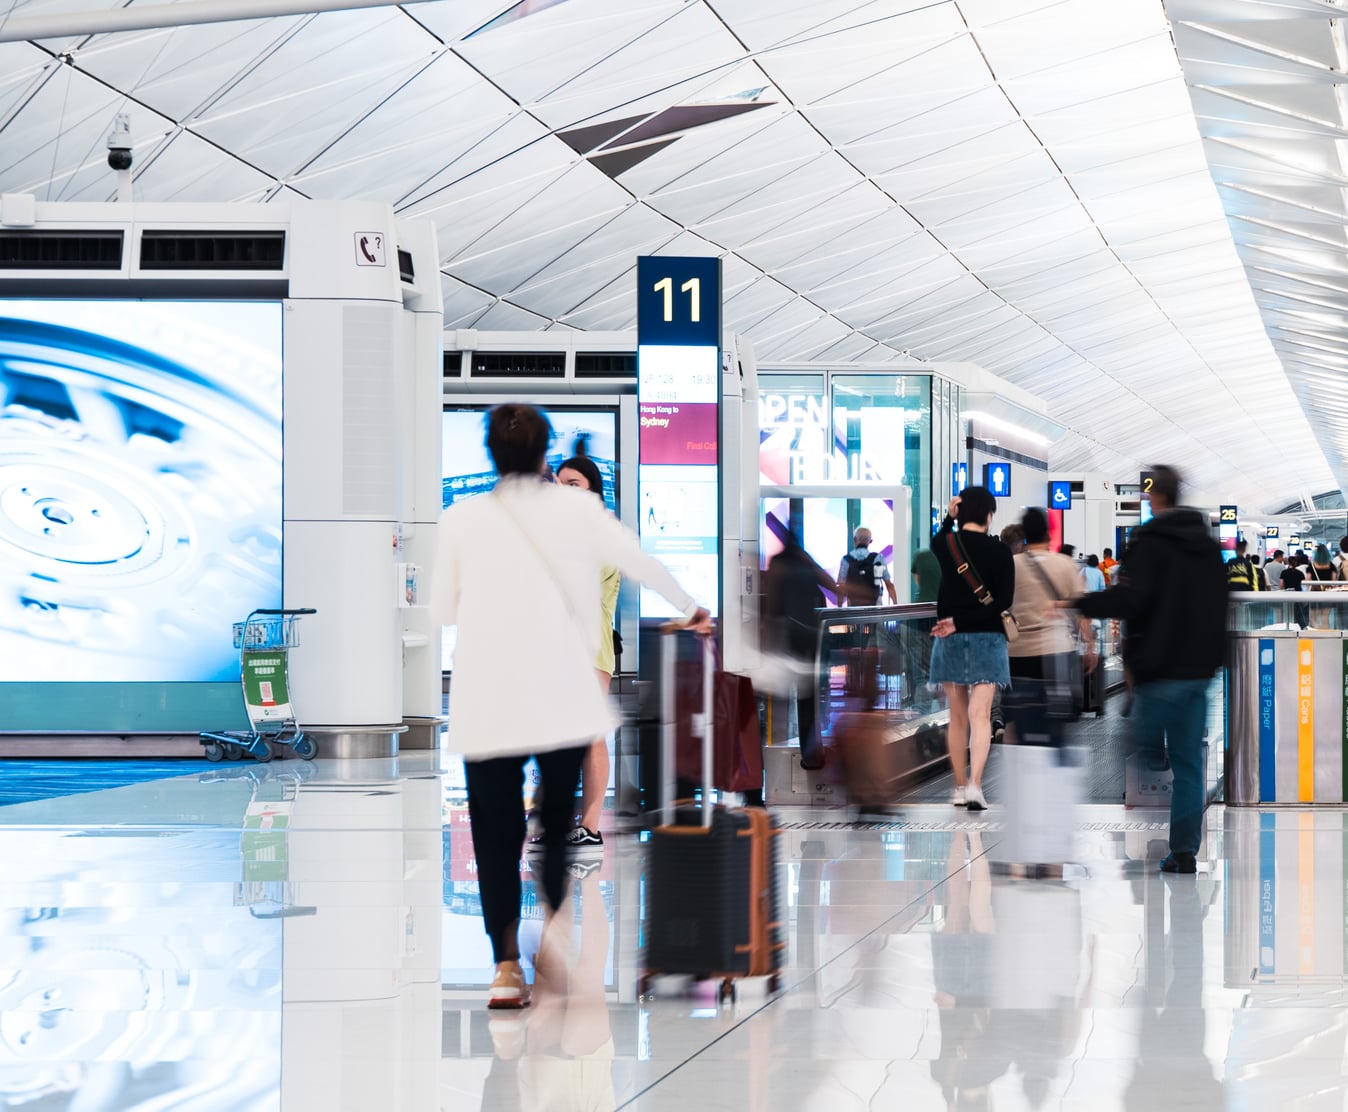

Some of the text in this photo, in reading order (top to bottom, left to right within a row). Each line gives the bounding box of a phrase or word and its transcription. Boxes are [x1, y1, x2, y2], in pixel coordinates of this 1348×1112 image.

[654, 277, 700, 322] 11
[692, 374, 716, 385] 19:30
[640, 405, 656, 414] Hong
[657, 405, 672, 414] Kong
[758, 394, 829, 424] PEN
[640, 416, 669, 428] Sydney
[687, 441, 703, 449] Final
[1222, 509, 1236, 520] 25
[1267, 528, 1278, 536] 27
[1263, 699, 1272, 729] Paper
[1301, 700, 1311, 724] Cans
